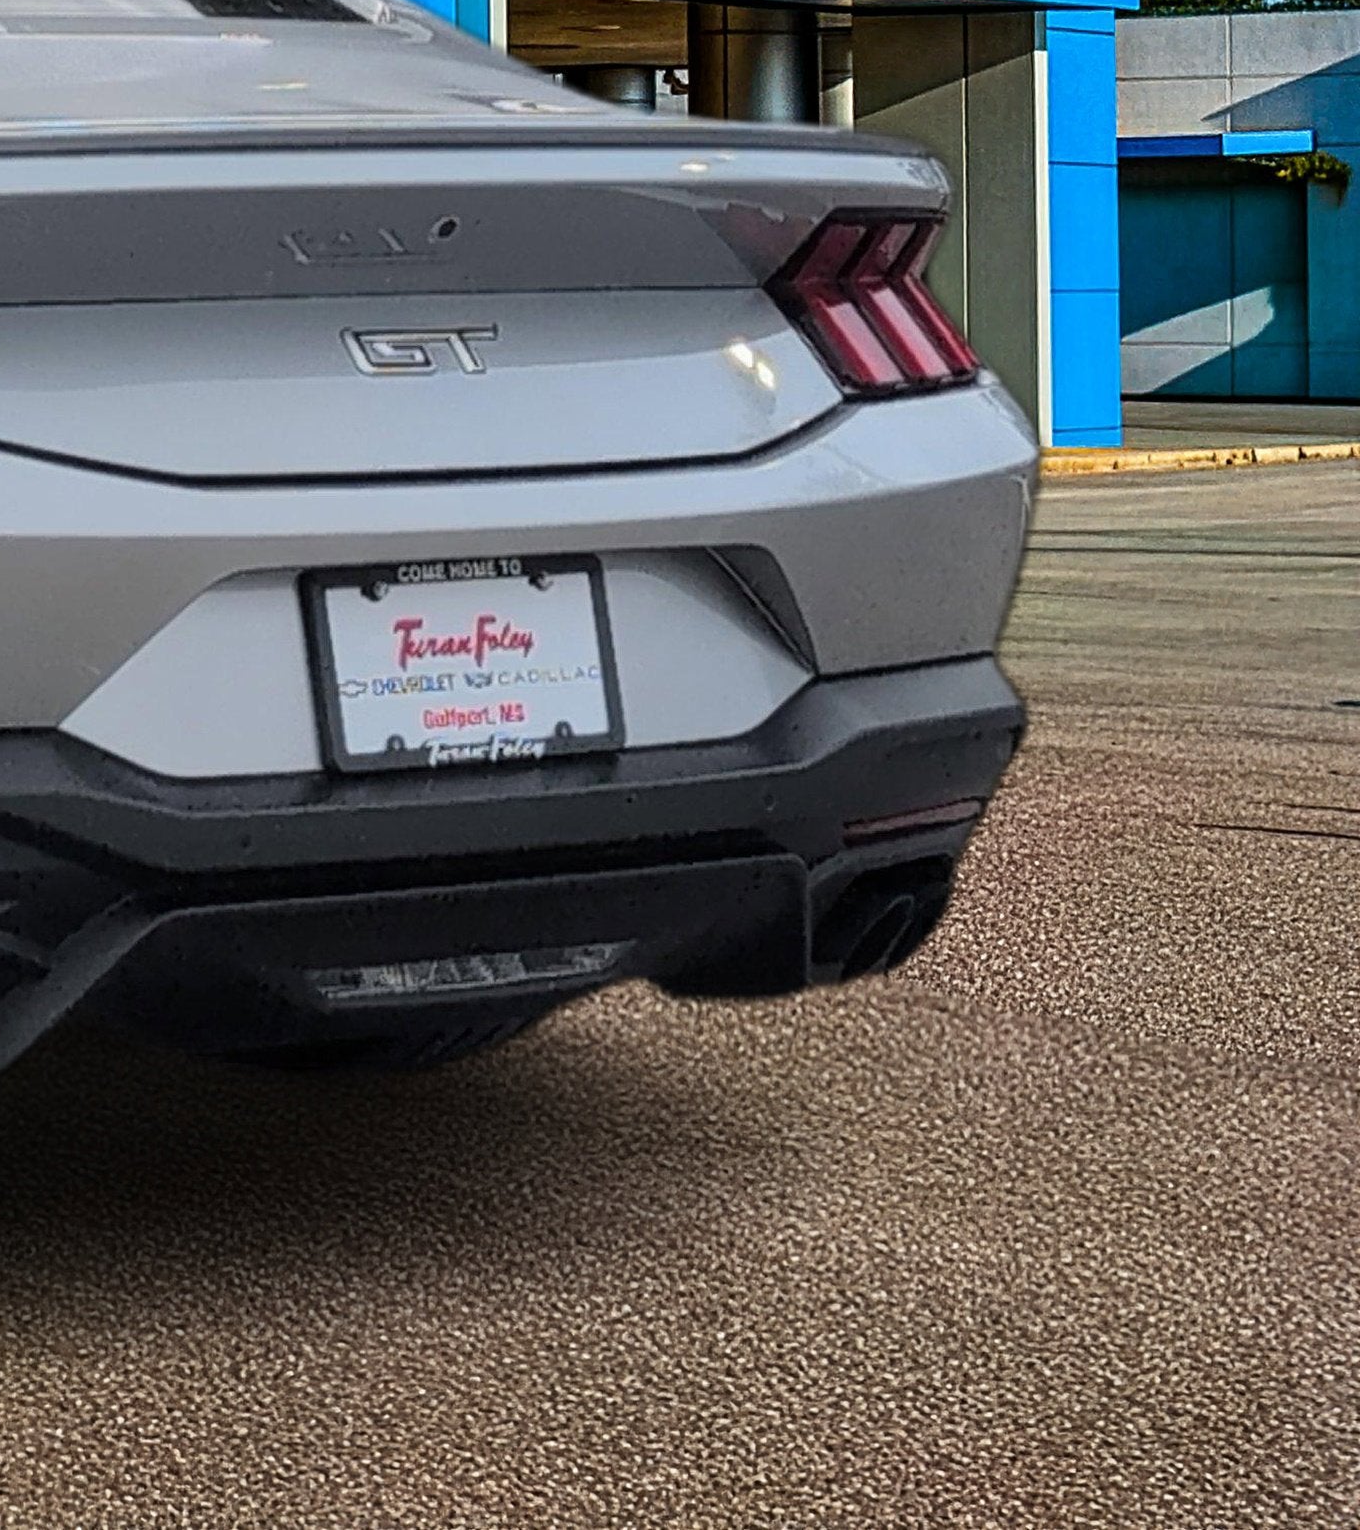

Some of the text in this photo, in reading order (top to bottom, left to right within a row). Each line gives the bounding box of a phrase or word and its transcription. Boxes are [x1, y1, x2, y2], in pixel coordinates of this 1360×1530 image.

[340, 323, 499, 375] GT
[397, 558, 522, 583] COME HOME TO
[371, 665, 602, 698] CHEVROLET CADILLAC
